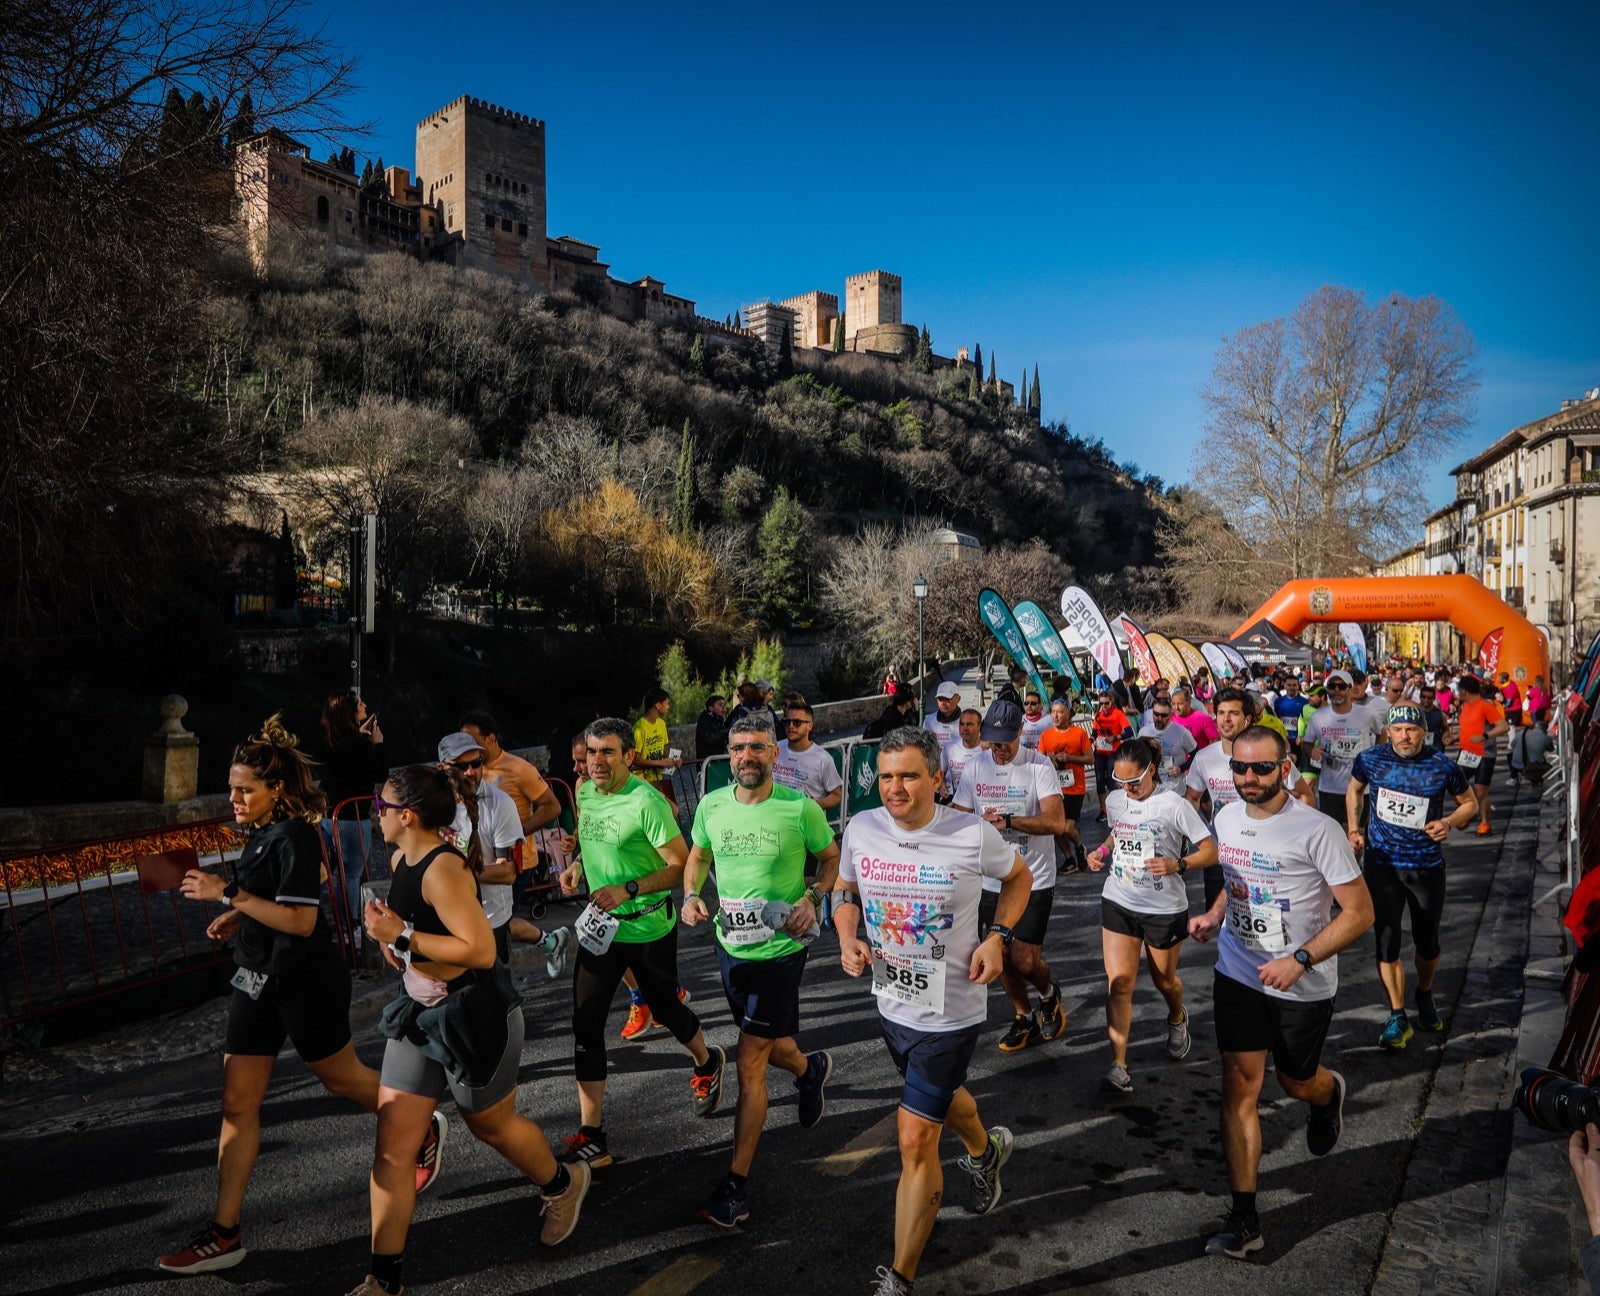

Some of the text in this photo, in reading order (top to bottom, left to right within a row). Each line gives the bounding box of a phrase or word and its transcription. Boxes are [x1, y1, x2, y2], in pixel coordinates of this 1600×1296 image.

[1407, 592, 1444, 600] GRANADA
[1400, 601, 1435, 609] Deportes
[1338, 740, 1356, 750] 397
[976, 783, 982, 797] 9
[1209, 777, 1214, 790] 9
[1381, 789, 1386, 798] 9
[1387, 800, 1416, 815] 212
[1120, 839, 1142, 852] 254
[1220, 842, 1250, 857] Carrera
[861, 856, 916, 878] 9 Carrera
[1220, 853, 1251, 868] olidaria
[869, 869, 919, 884] Solidaria
[584, 913, 608, 939] 356
[727, 911, 758, 926] 184
[1232, 910, 1268, 934] 536
[875, 948, 911, 966] 9 Carrera
[886, 964, 929, 990] 585
